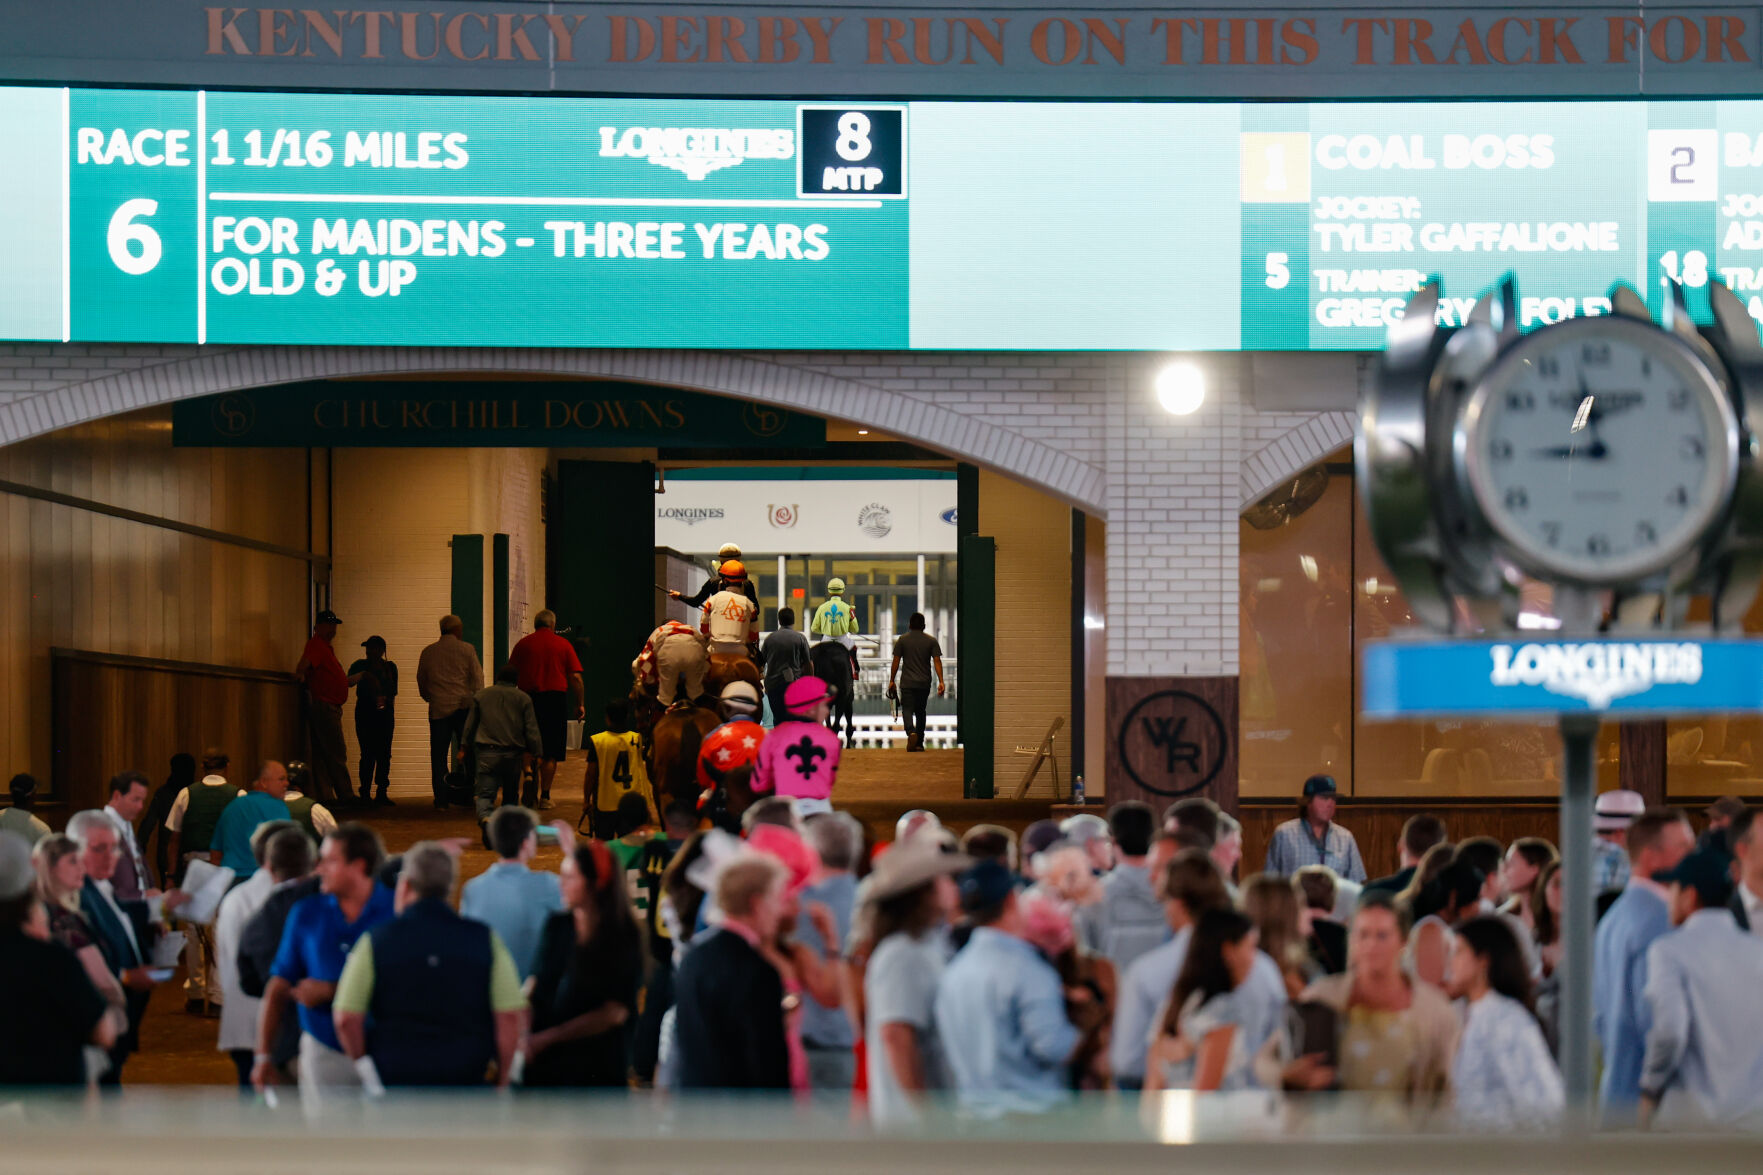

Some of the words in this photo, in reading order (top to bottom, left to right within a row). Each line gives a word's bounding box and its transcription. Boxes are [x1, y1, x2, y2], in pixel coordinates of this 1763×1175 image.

[205, 7, 587, 62] KENTUCKY
[606, 15, 838, 65] DERBY
[867, 17, 1010, 66] RUN
[1030, 17, 1131, 66] ON
[1150, 17, 1319, 66] THIS
[1342, 16, 1586, 66] TRACK
[1603, 15, 1752, 64] FOR
[77, 127, 190, 167] RACE
[210, 129, 235, 166] 1
[243, 129, 333, 168] 1/16
[344, 131, 469, 169] MILES
[599, 126, 795, 160] LONGINES
[835, 111, 873, 162] 8
[1315, 134, 1436, 170] COAL
[1443, 133, 1555, 170] BOSS
[822, 167, 884, 191] MTP
[1264, 143, 1288, 191] 1
[1670, 146, 1696, 184] 2
[106, 198, 163, 275] 6
[213, 216, 299, 255] FOR
[311, 218, 506, 258] MAIDENS
[543, 220, 686, 259] THREE
[694, 223, 830, 261] YEARS
[1314, 223, 1415, 251] TYLER
[1419, 222, 1619, 251] GAFFALIONE
[211, 257, 305, 296] OLD
[314, 259, 347, 297] &
[358, 260, 417, 297] UP
[1265, 252, 1290, 289] 5
[1659, 250, 1708, 288] 18
[1315, 297, 1478, 327] GREGRY
[313, 400, 529, 428] CHURCHILL
[545, 400, 686, 428] DOWNS
[658, 507, 725, 519] LONGINES
[1489, 642, 1703, 685] LONGINES
[612, 750, 634, 790] 4
